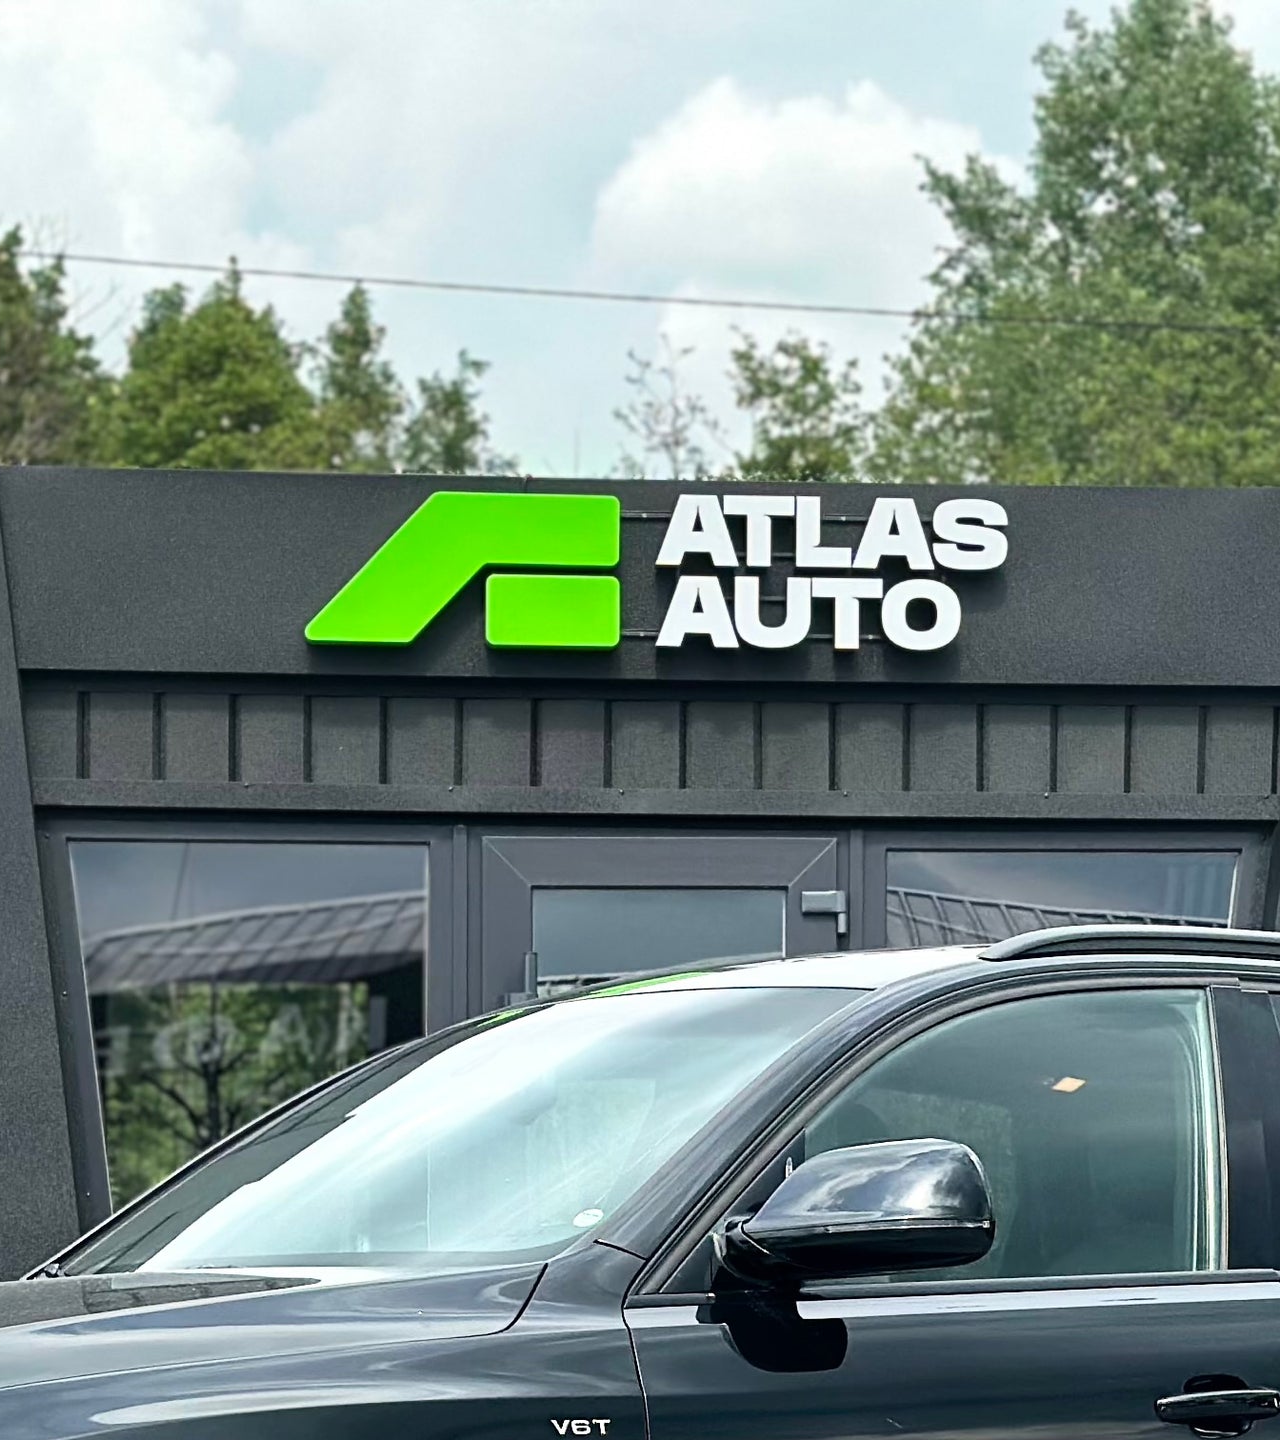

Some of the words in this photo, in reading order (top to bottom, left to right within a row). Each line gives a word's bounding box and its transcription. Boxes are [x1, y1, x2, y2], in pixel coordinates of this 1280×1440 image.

[655, 494, 1010, 571] ATLAS
[655, 575, 963, 651] AUTO
[550, 1419, 611, 1435] V6T
